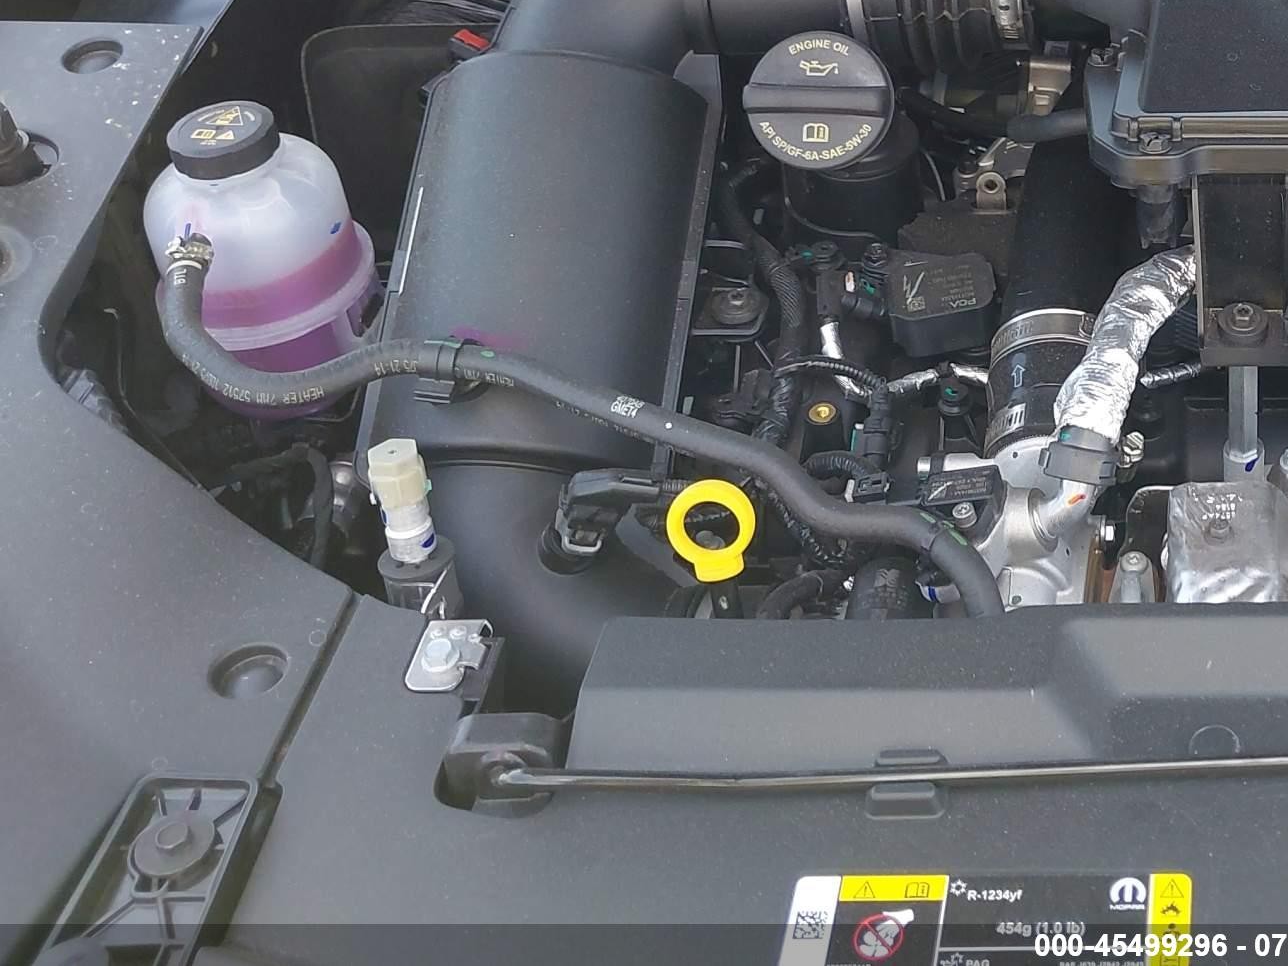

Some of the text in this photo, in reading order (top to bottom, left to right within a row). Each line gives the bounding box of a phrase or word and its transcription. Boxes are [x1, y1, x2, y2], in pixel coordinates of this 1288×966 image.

[788, 39, 850, 56] ENGINE OIL
[759, 121, 773, 139] API
[255, 392, 276, 406] 7MM
[283, 386, 325, 404] HEATER
[967, 889, 1023, 903] R-1234yf
[996, 921, 1086, 937] 454g (1.0 lb)
